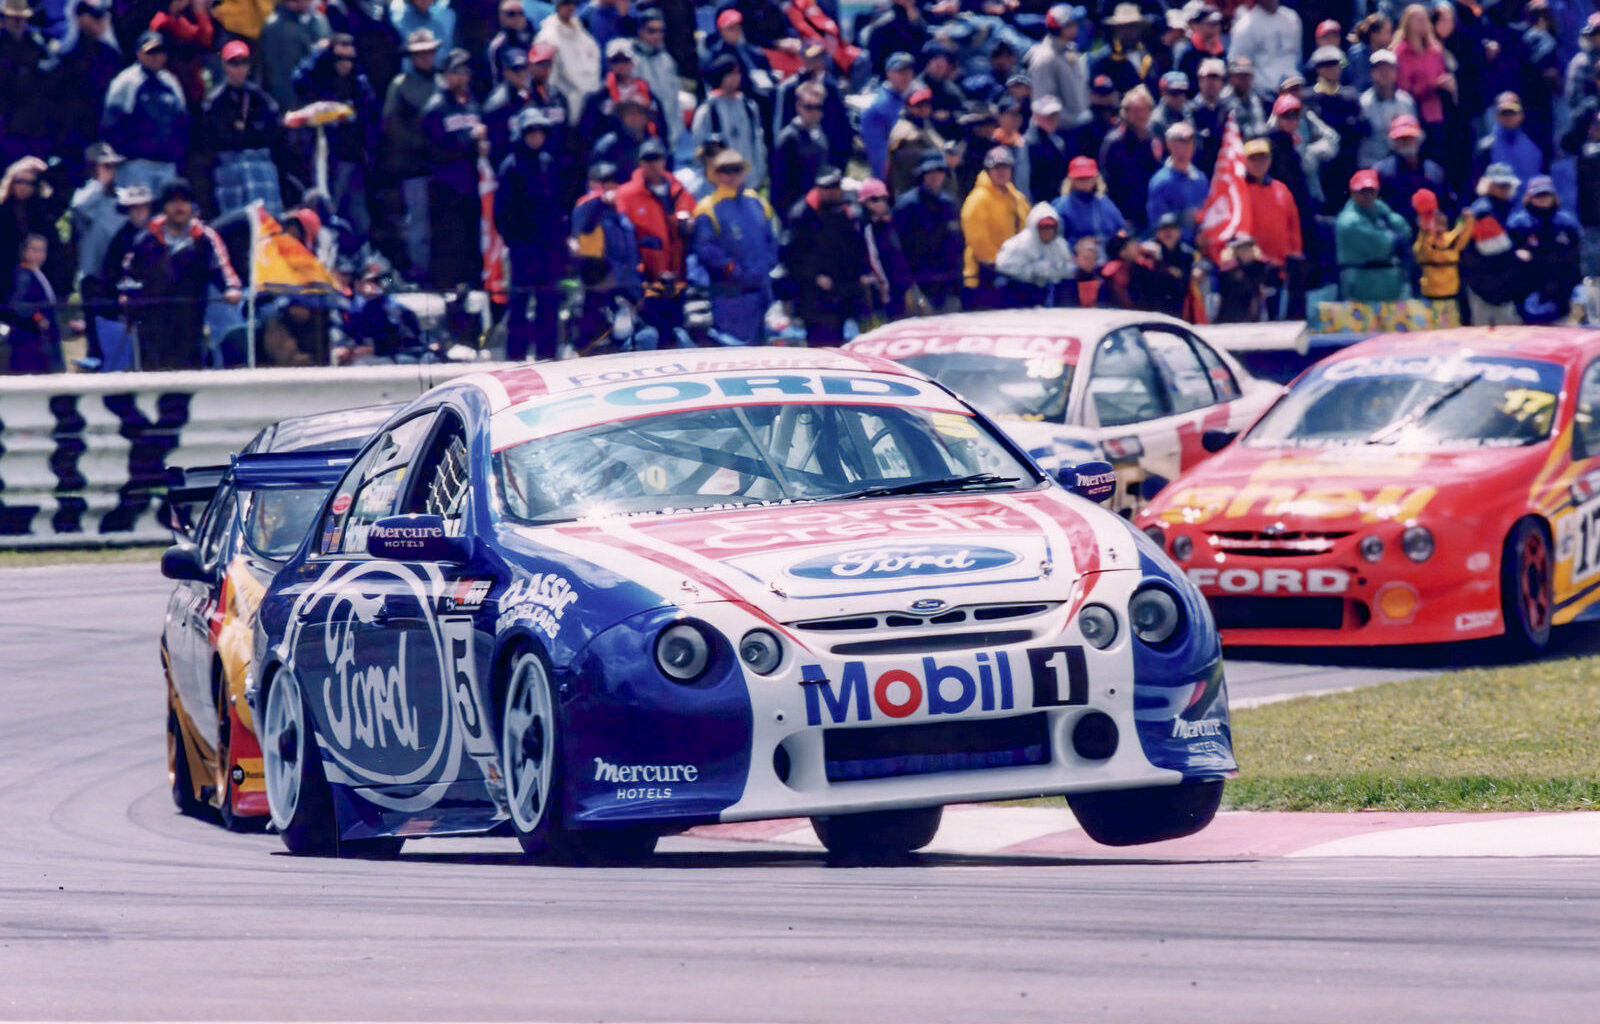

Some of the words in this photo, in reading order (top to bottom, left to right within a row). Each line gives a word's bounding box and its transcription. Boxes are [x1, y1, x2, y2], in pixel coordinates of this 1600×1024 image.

[853, 334, 1069, 361] HOLDEN
[567, 363, 688, 388] Ford
[513, 374, 920, 428] FORD
[703, 508, 1026, 549] Credit
[711, 503, 950, 532] Ford
[384, 539, 425, 548] HOTELS
[830, 549, 976, 576] Ford
[1187, 568, 1350, 593] FORD
[452, 638, 481, 739] 5
[800, 650, 1014, 726] Mobil
[1045, 651, 1070, 701] 1
[593, 757, 699, 783] Mercure
[616, 788, 673, 800] HOTELS
